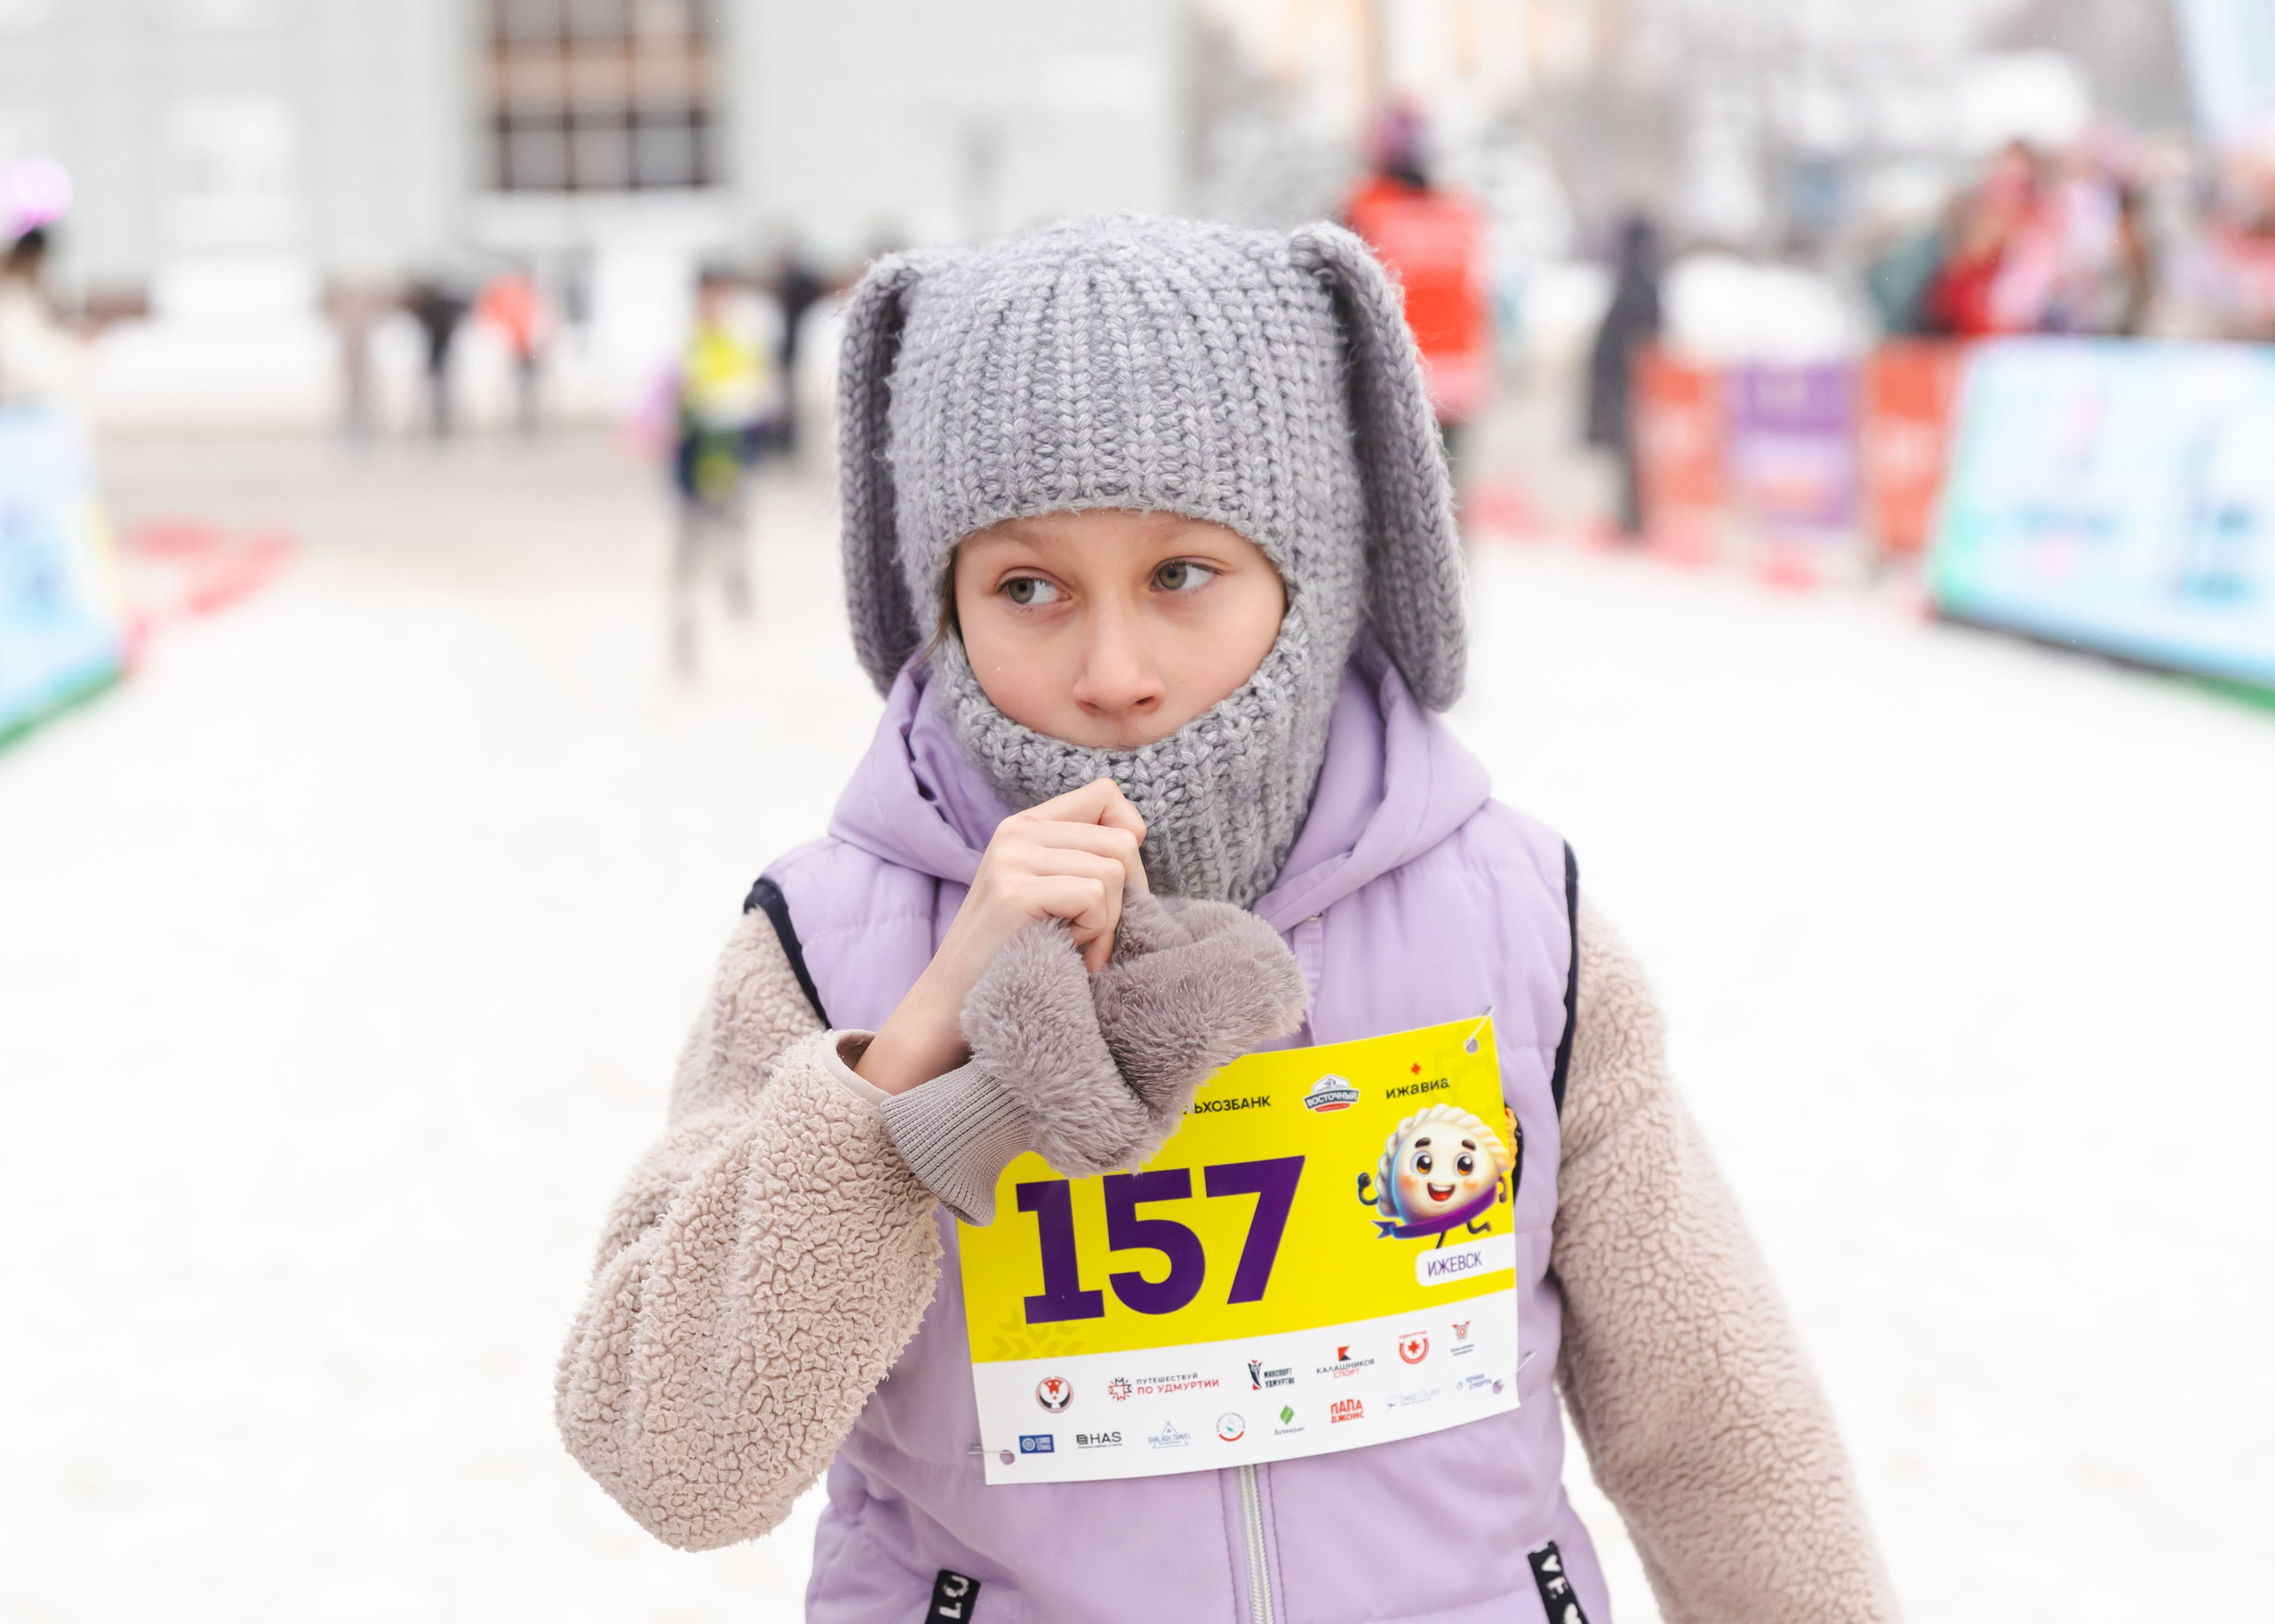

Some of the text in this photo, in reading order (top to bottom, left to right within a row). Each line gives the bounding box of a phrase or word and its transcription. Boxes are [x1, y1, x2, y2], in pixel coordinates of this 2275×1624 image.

[1385, 1078, 1449, 1100] ижавиа
[1182, 1095, 1271, 1115] ЬХОЗБАНК
[1306, 1090, 1358, 1107] ВОСТОЧНЫЙ
[1016, 1155, 1305, 1325] 157
[1427, 1251, 1482, 1277] ИЖЕВСК
[1316, 1358, 1375, 1373] КАЛАШНИКОВ
[1333, 1367, 1360, 1379] СПОРТ
[1137, 1372, 1198, 1385] ПУТЕШЕСТВУЙ
[1157, 1379, 1220, 1393] УДМУРТИИ
[1330, 1399, 1363, 1414] ПАПА
[1330, 1411, 1365, 1423] ДЖОНС
[1090, 1431, 1122, 1444] HAS
